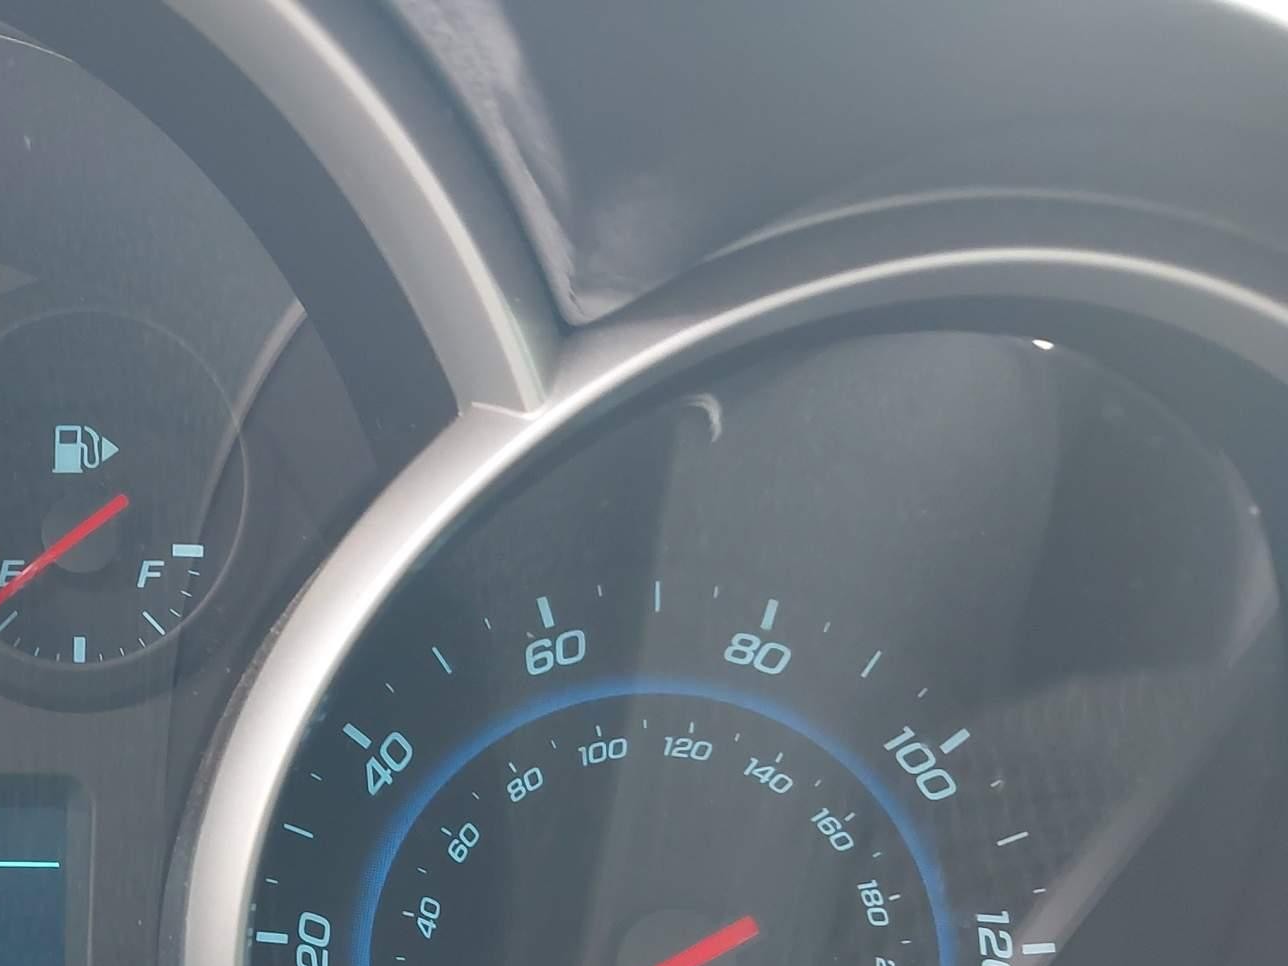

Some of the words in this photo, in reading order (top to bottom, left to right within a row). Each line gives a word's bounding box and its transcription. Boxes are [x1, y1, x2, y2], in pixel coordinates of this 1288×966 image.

[137, 560, 165, 588] F
[525, 630, 586, 675] 60
[724, 633, 791, 675] 80
[364, 732, 413, 795] 40
[578, 738, 628, 766] 100
[663, 736, 713, 761] 120
[883, 726, 957, 800] 100
[506, 767, 544, 802] 80
[743, 757, 793, 794] 140
[447, 823, 480, 863] 60
[811, 808, 854, 851] 160
[418, 896, 441, 939] 40
[857, 880, 889, 928] 180
